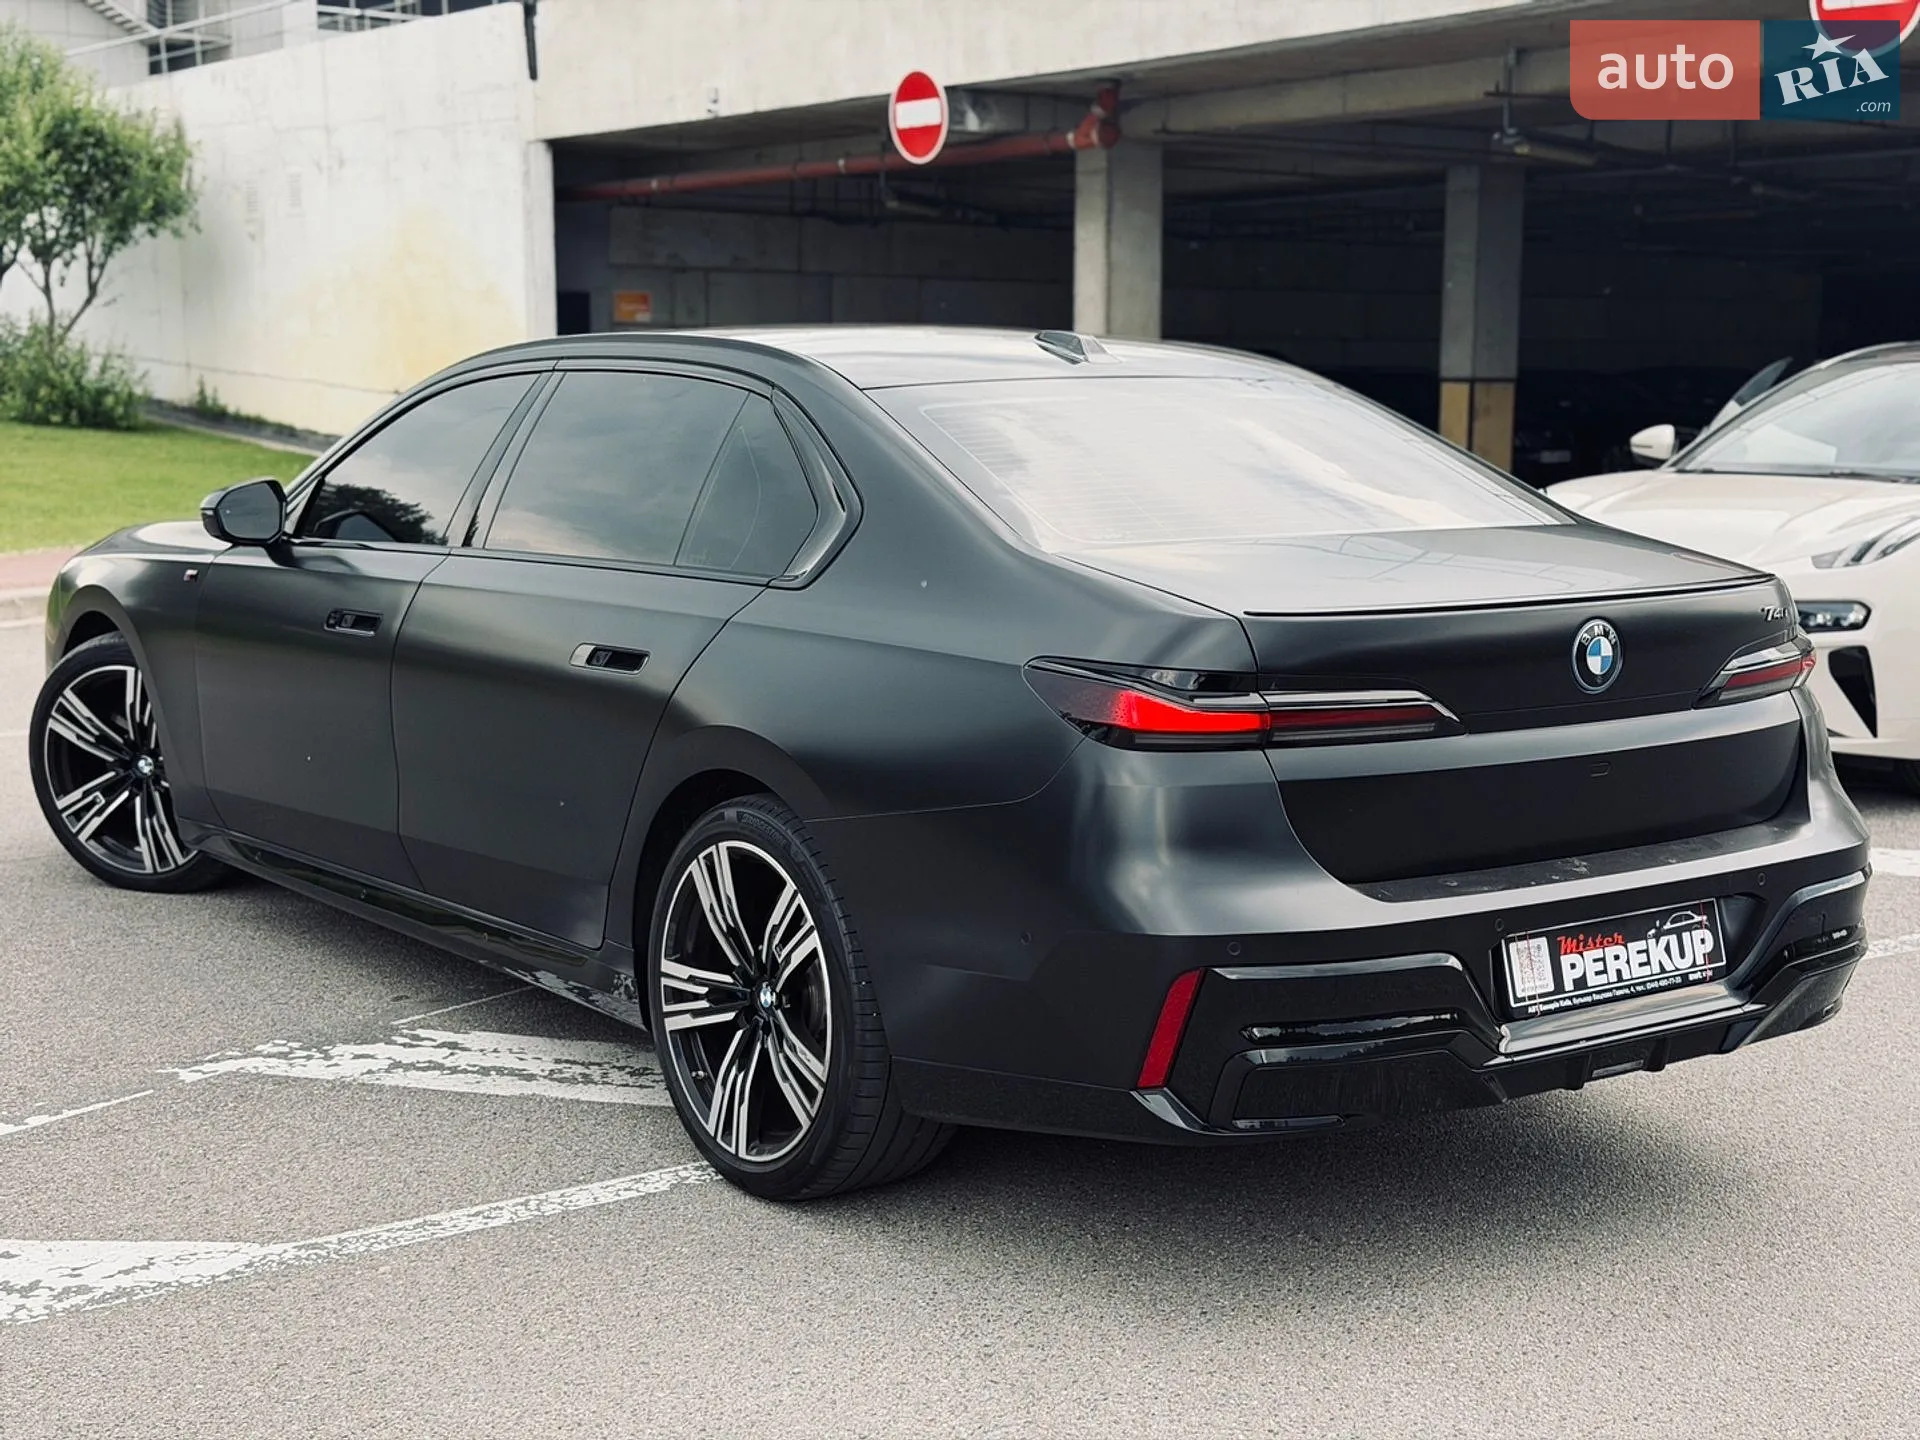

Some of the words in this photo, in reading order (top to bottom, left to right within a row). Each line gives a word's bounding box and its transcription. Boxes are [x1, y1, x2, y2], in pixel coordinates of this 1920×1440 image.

[1581, 624, 1616, 646] BMW
[1556, 931, 1625, 955] Mister
[1560, 929, 1715, 991] PEREKUP
